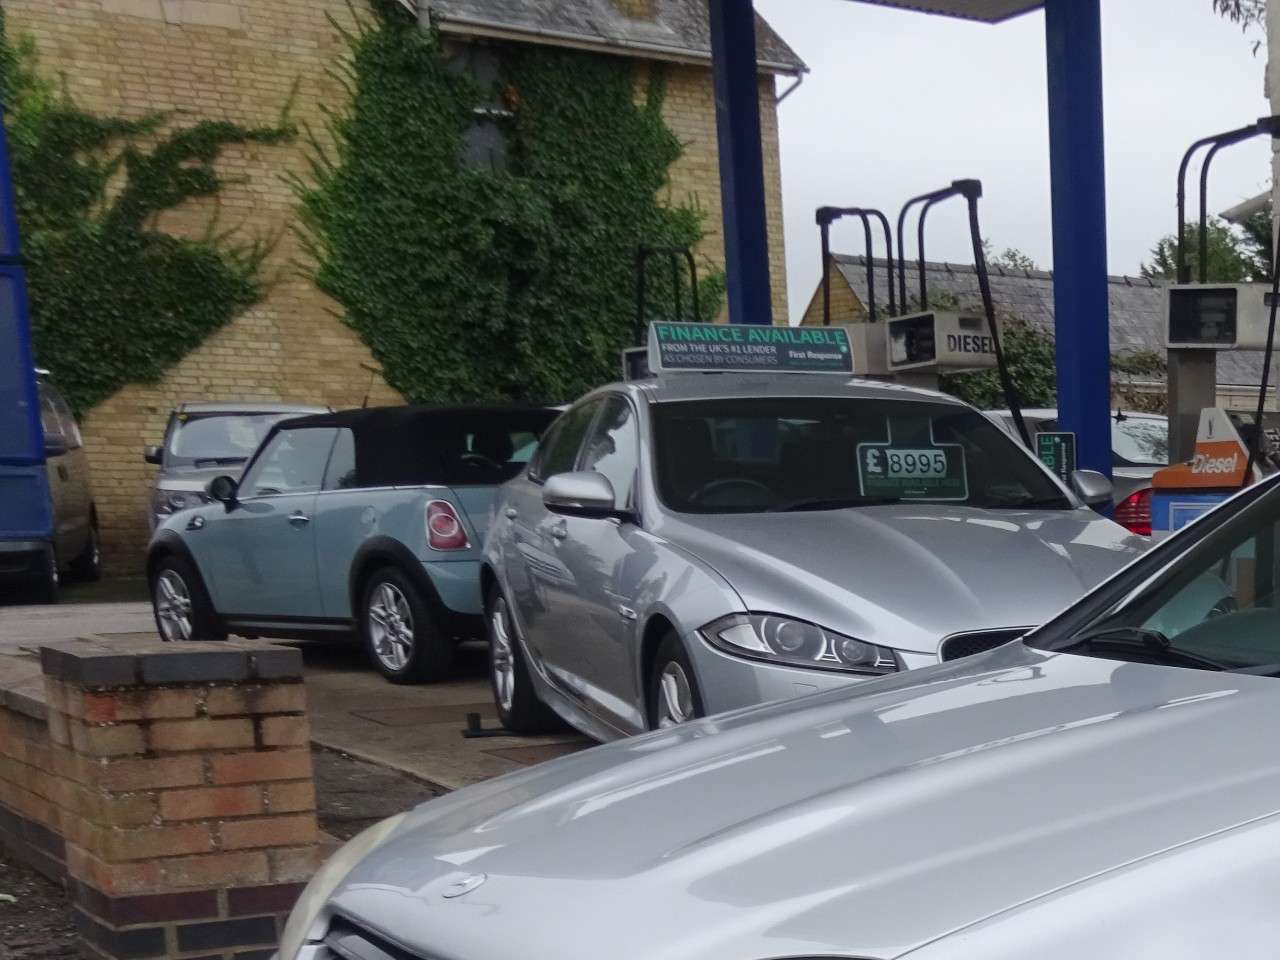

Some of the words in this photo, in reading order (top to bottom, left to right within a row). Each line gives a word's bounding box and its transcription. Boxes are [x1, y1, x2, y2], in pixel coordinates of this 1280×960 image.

[657, 325, 744, 342] FINANCE
[749, 328, 847, 345] AVAILABLE
[947, 334, 998, 354] DIESEL
[661, 343, 688, 352] FROM
[689, 344, 707, 352] THE
[743, 345, 777, 354] LENDER
[1191, 452, 1238, 474] Diesel
